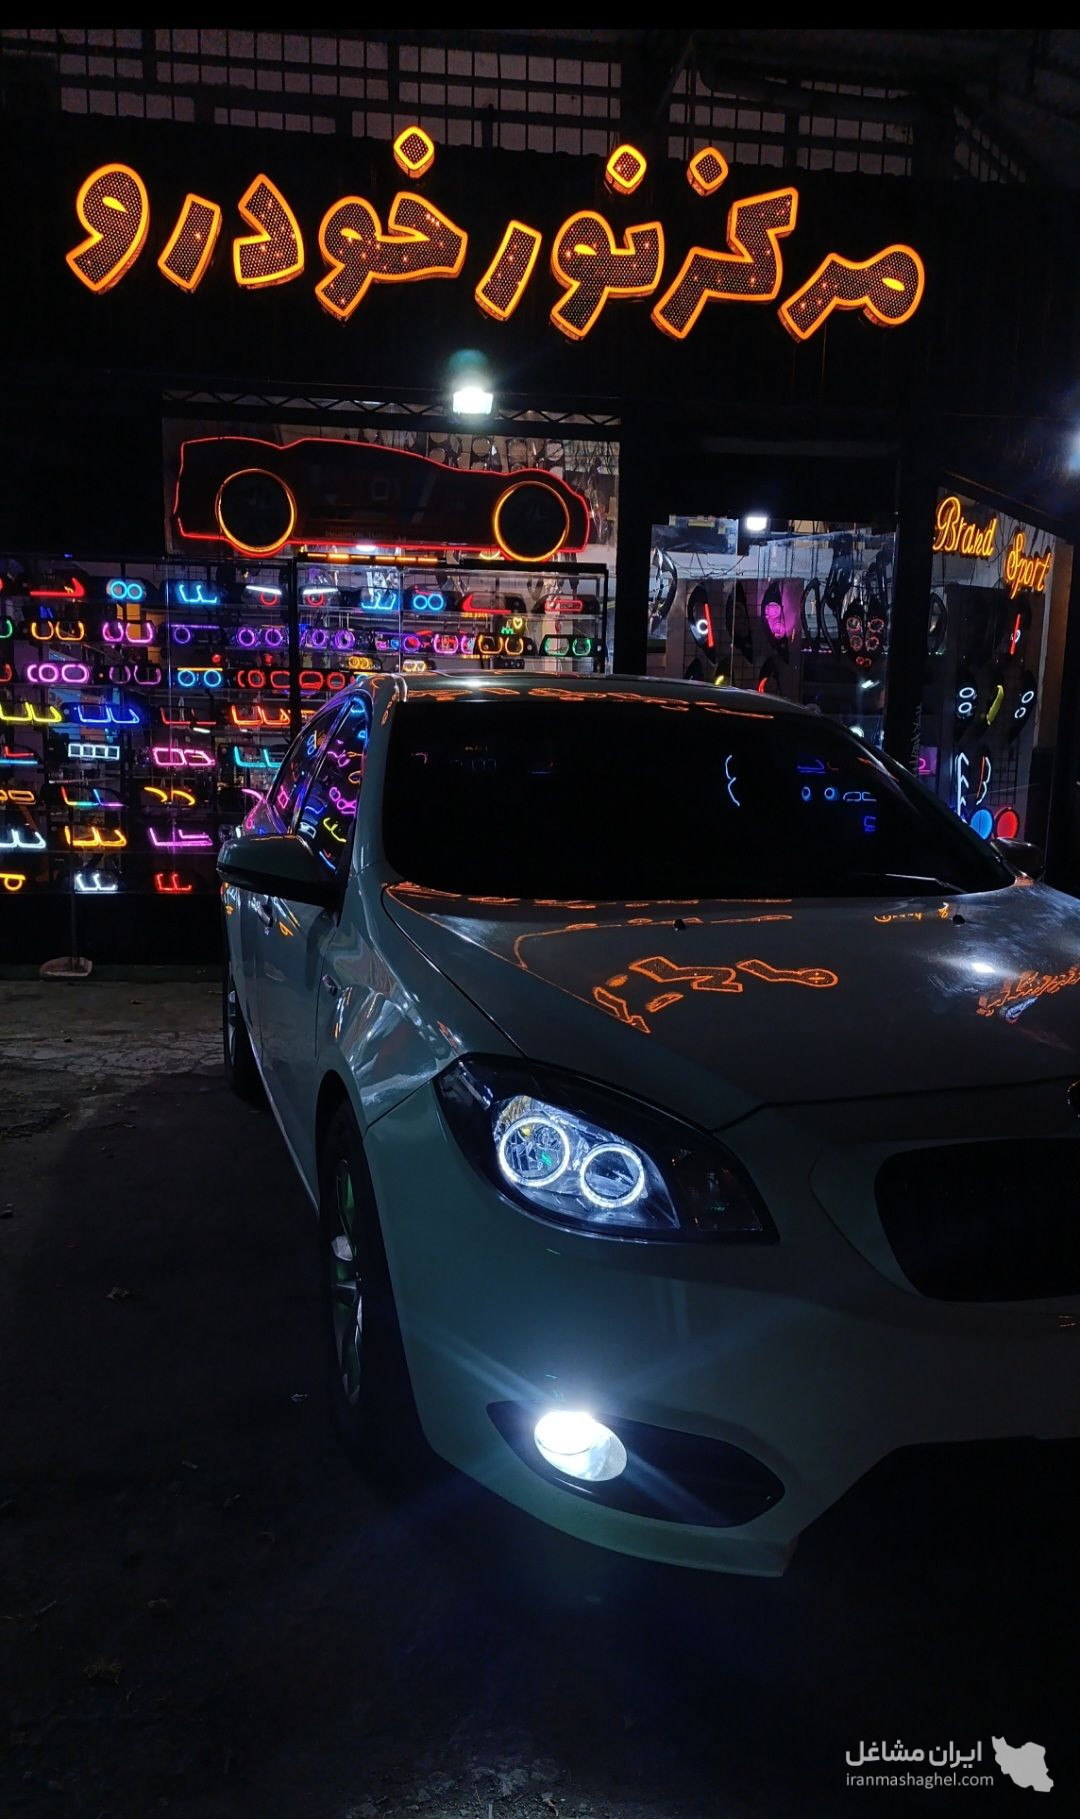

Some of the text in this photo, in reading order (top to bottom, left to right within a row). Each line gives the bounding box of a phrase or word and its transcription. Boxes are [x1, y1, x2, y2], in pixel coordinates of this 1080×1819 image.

[65, 125, 926, 342] مرکز نور خودرو
[932, 496, 1053, 600] Brand Sport
